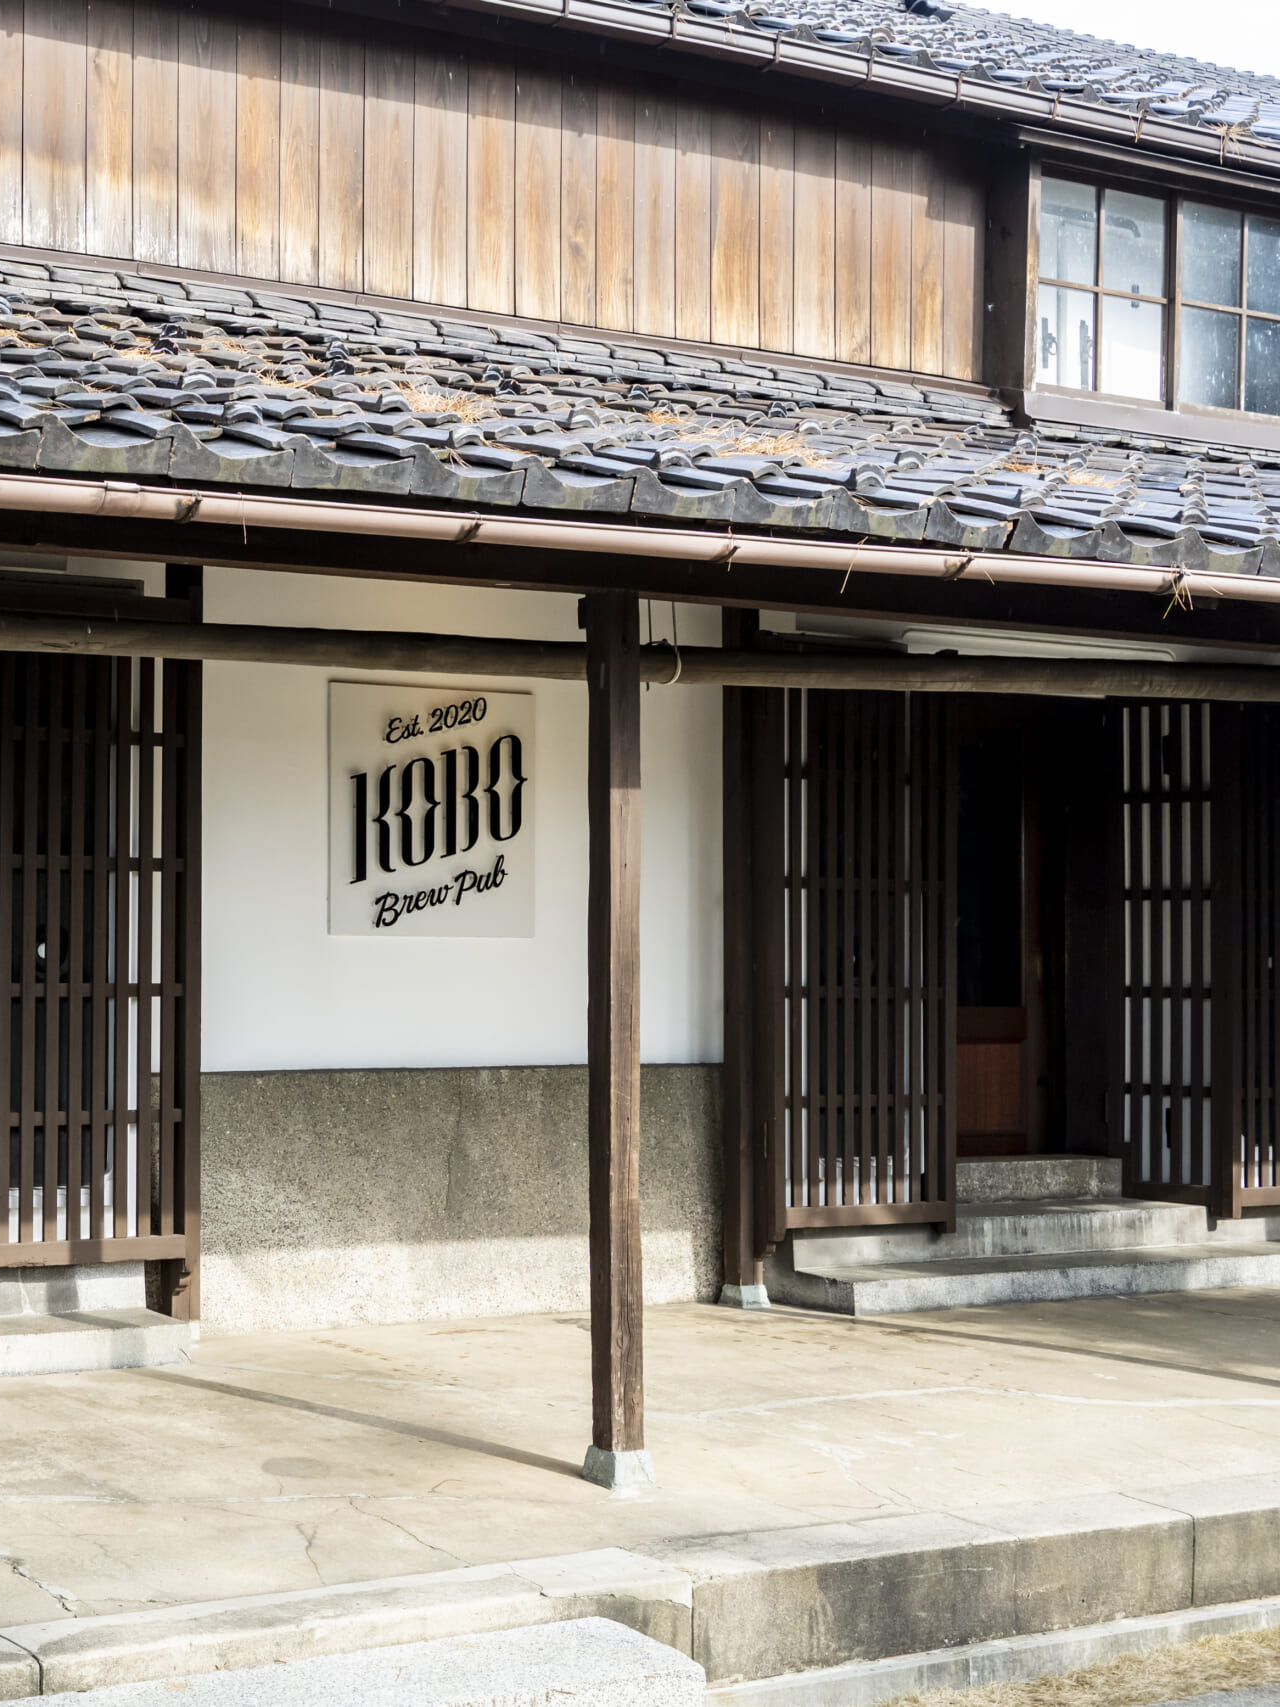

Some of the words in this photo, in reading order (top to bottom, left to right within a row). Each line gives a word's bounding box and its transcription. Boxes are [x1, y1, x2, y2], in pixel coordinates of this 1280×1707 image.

[385, 714, 424, 743] Est.
[428, 697, 487, 732] 2020
[350, 734, 528, 884] KOBO
[375, 884, 454, 928] Brew
[454, 854, 508, 905] Pub
